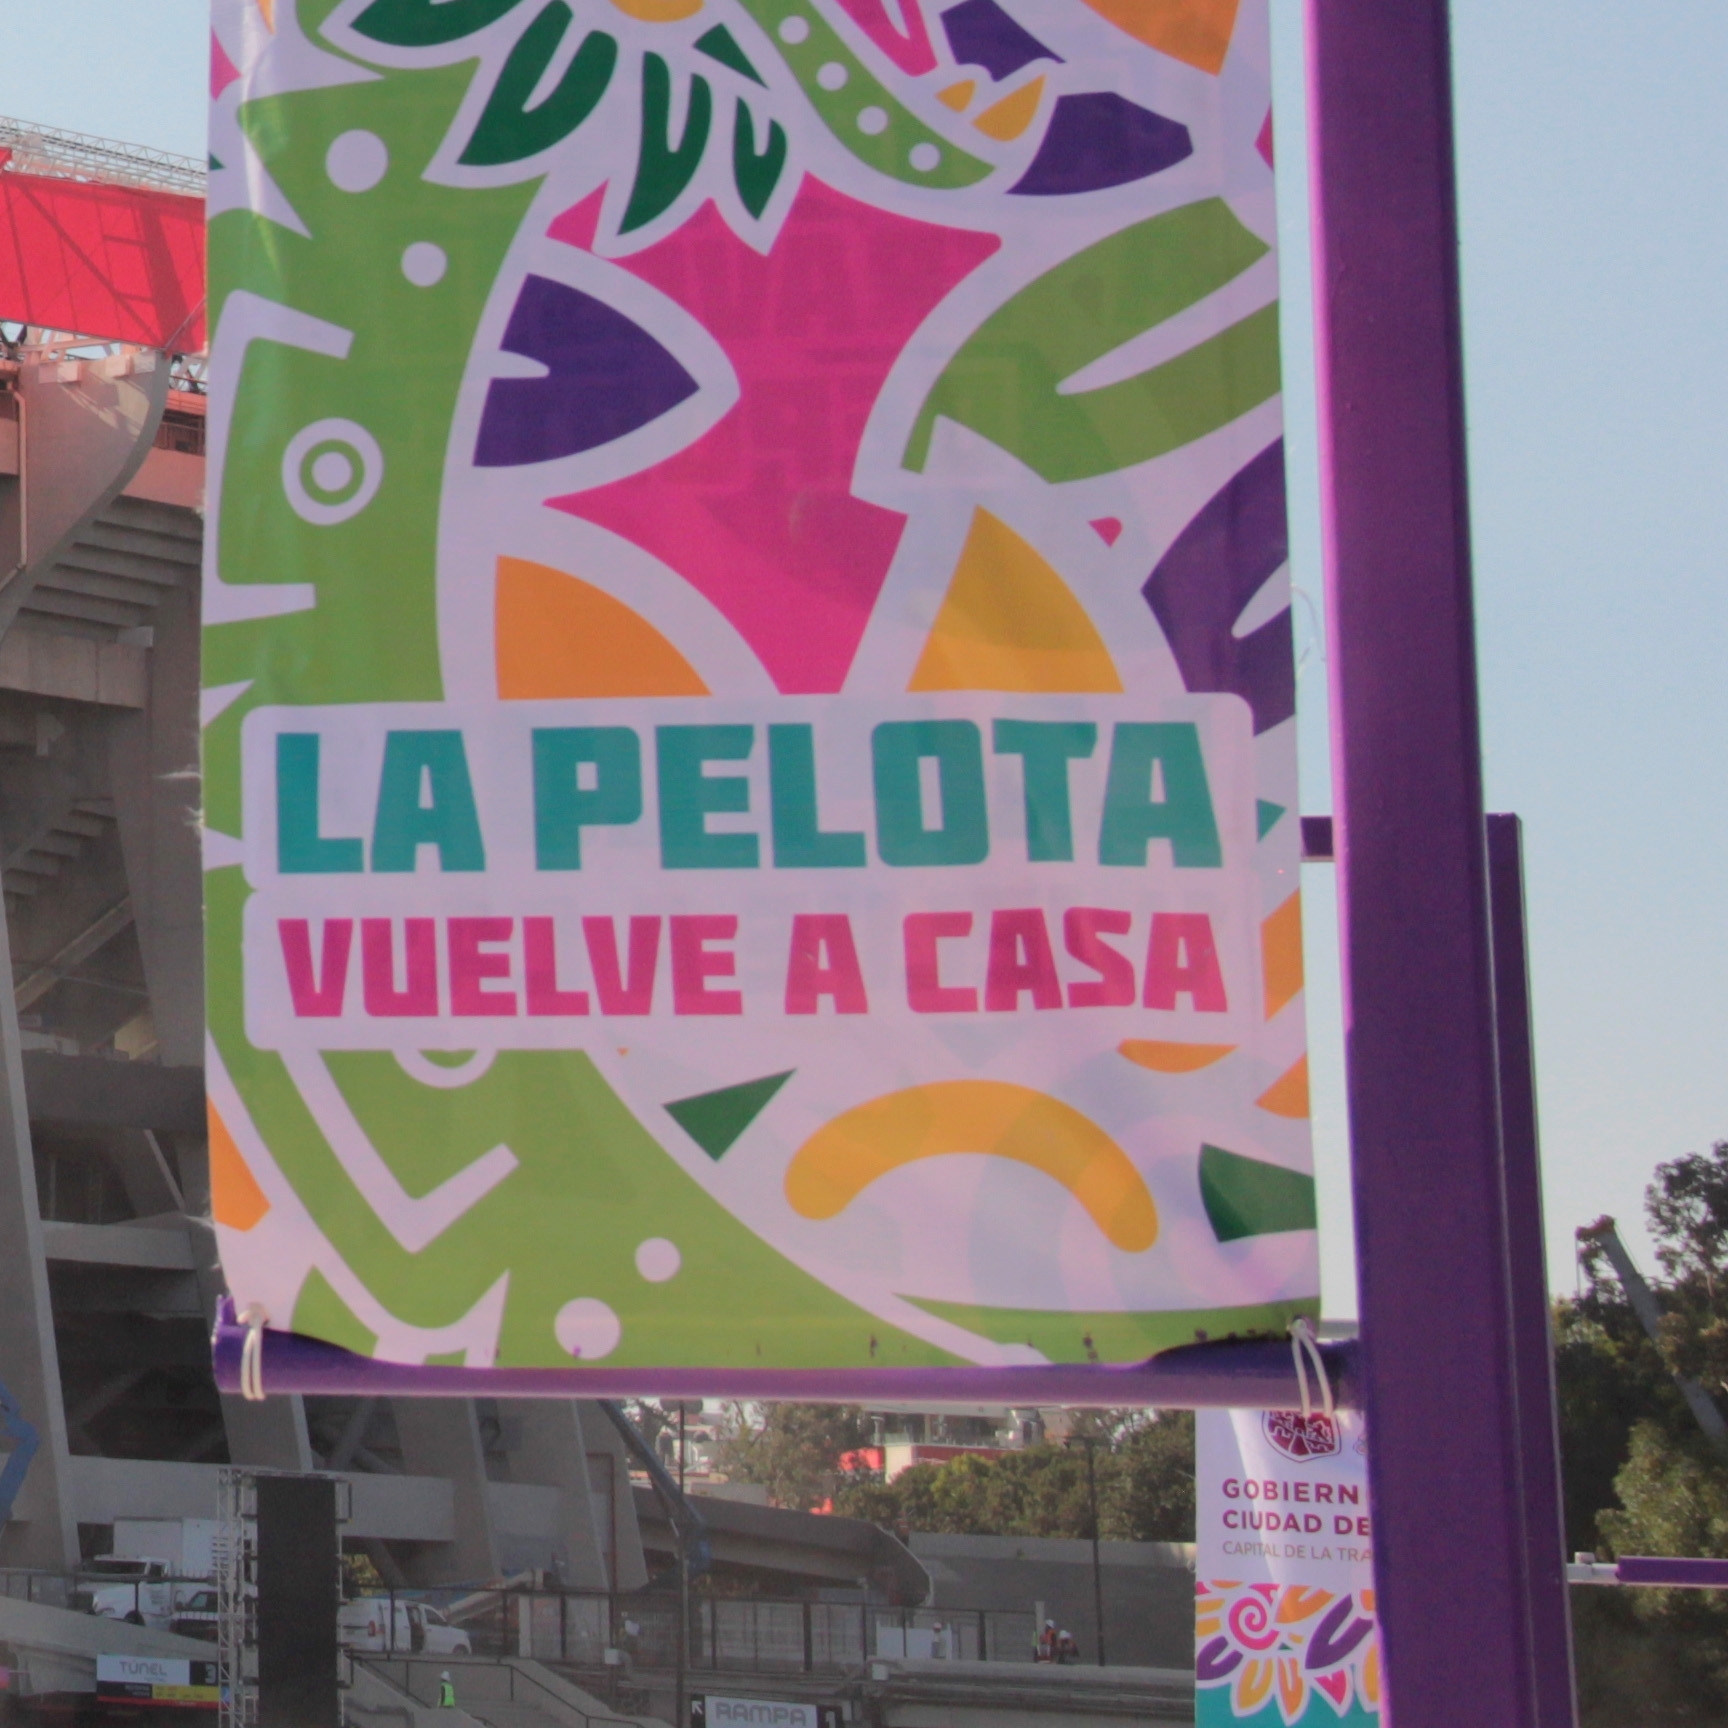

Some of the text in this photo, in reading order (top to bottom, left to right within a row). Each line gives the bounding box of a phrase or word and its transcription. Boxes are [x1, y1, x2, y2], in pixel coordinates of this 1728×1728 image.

[276, 718, 1223, 873] LA PELOTA
[276, 906, 1228, 1017] VUELVE A CASA
[1222, 1478, 1360, 1504] GOBIERN
[1222, 1509, 1371, 1536] CIUDAD DE
[1222, 1540, 1373, 1563] CAPITAL DE LA TRA
[204, 1663, 217, 1684] 3
[715, 1701, 807, 1727] RAMPA
